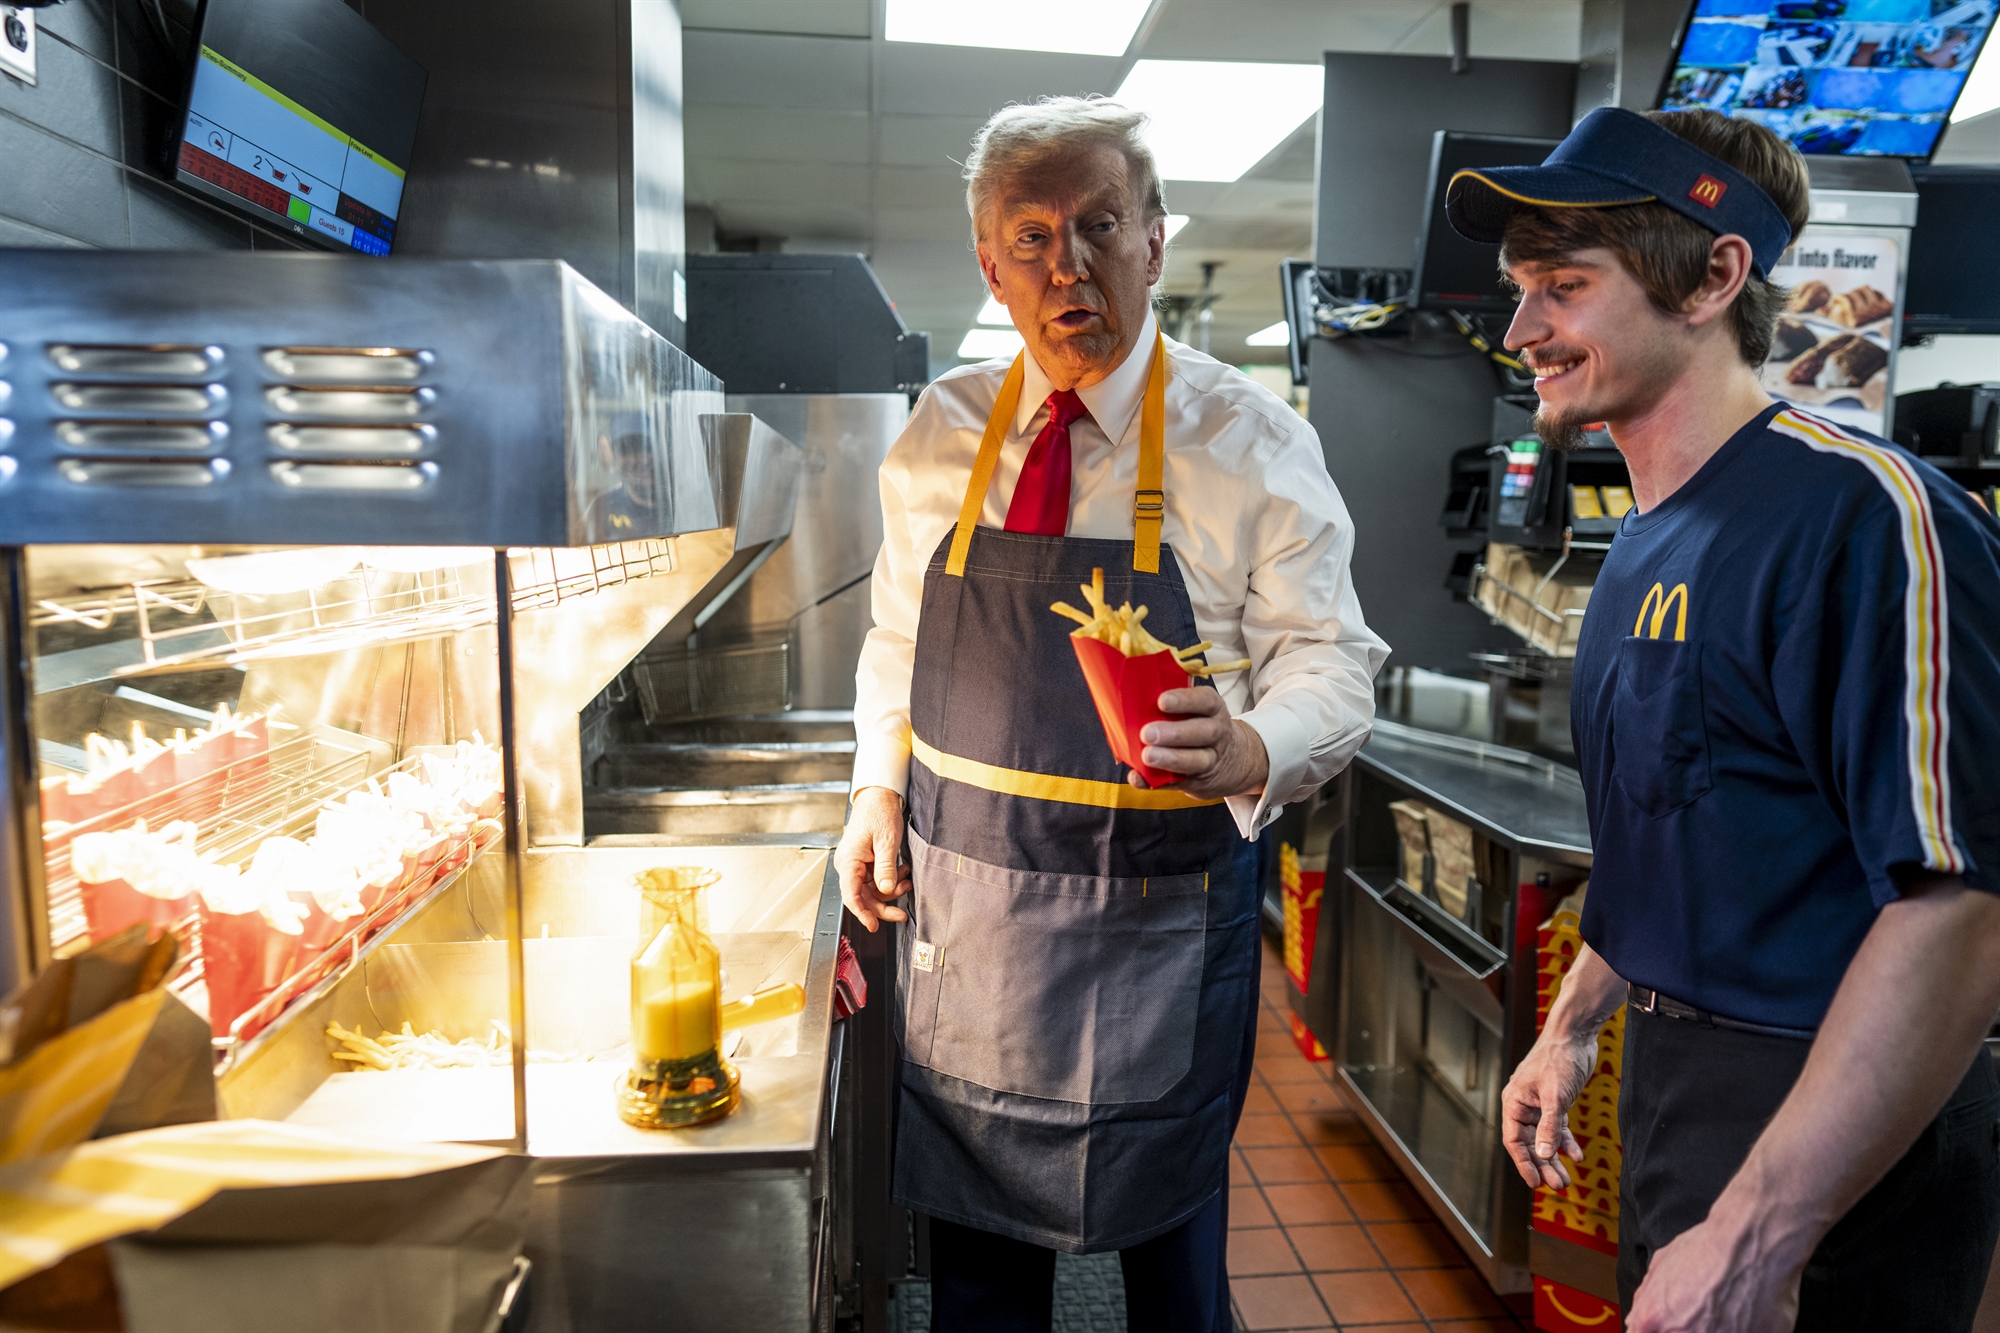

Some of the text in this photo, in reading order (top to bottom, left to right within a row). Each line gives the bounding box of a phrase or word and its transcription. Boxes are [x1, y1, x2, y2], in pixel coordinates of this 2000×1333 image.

[202, 48, 247, 82] Fries-Summary
[189, 117, 202, 128] AUTO
[350, 140, 373, 159] Fries-Level
[253, 155, 262, 170] 2
[344, 197, 365, 214] Update
[318, 218, 344, 235] Guests 15
[354, 240, 361, 249] 15
[1799, 246, 1829, 267] into
[1834, 249, 1878, 269] flavor
